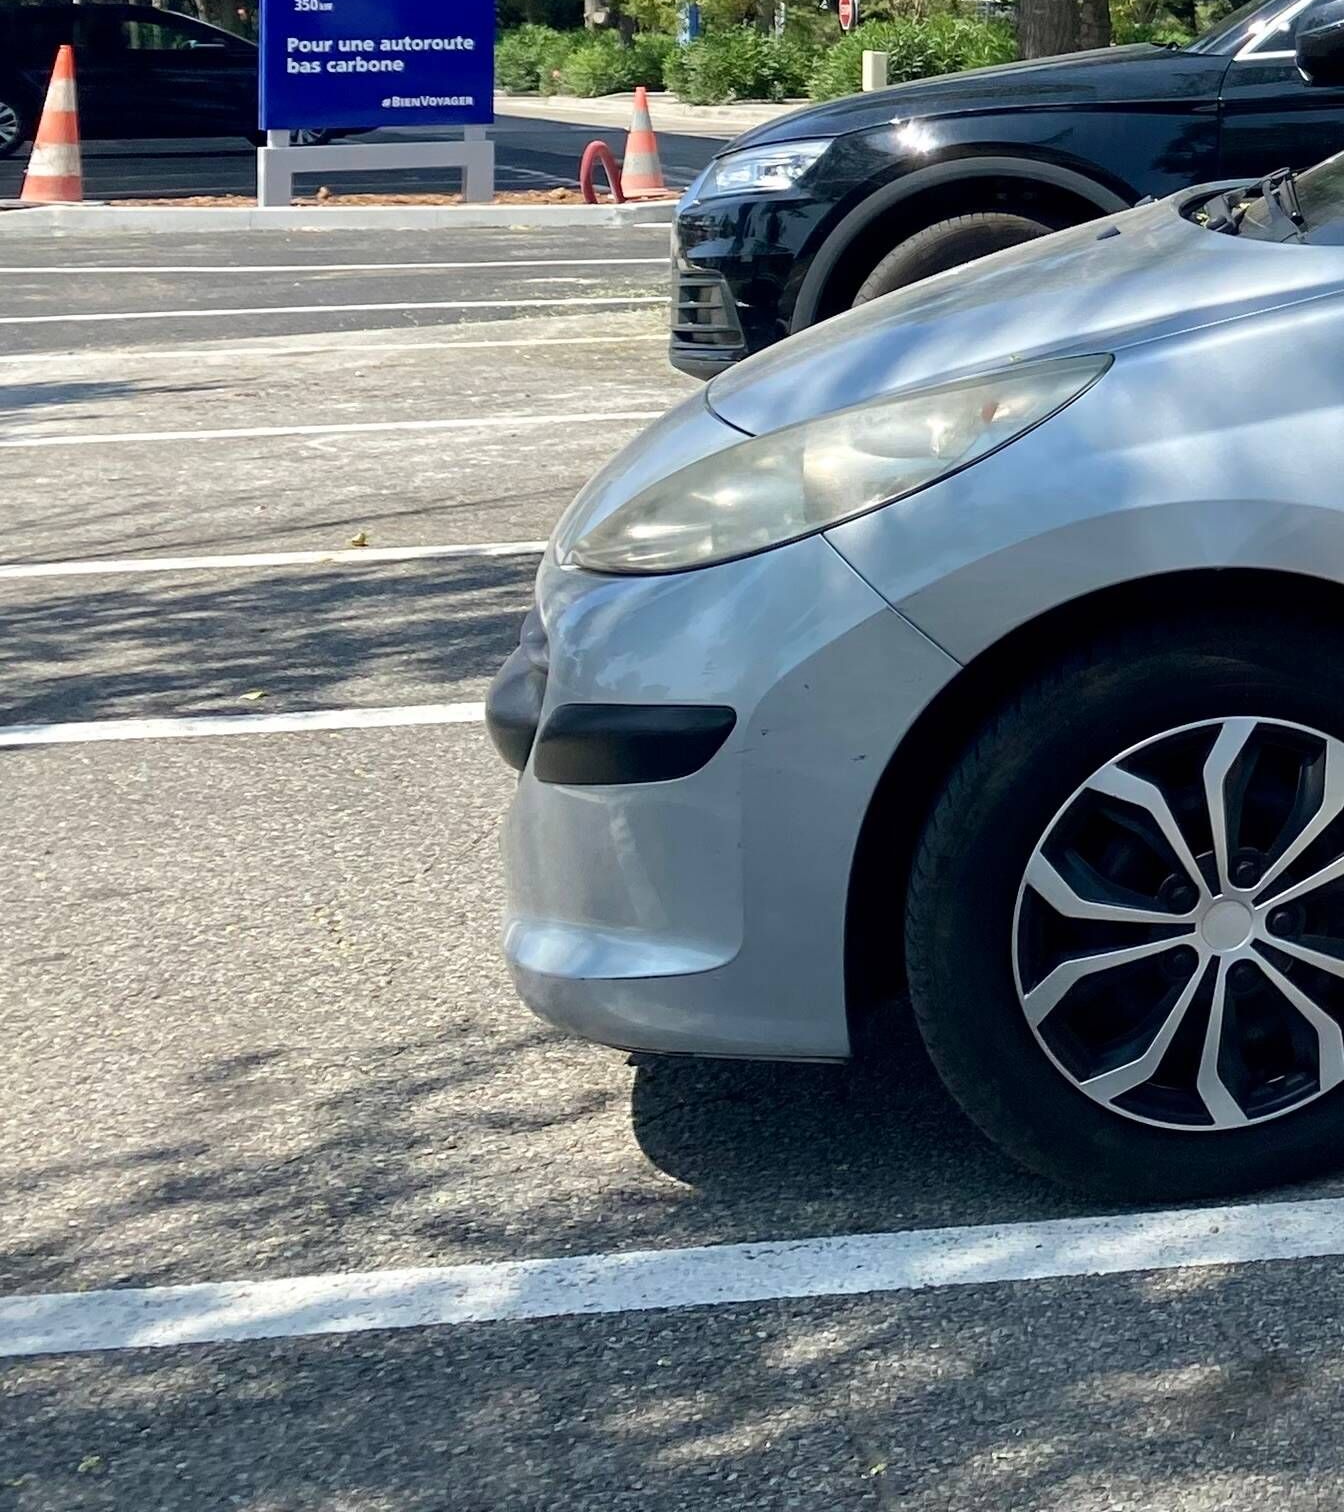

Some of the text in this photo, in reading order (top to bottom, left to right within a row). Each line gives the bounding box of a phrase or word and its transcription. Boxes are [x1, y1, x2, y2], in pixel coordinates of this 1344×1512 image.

[287, 35, 475, 53] Pour une autoroute
[286, 56, 404, 74] bas carbone
